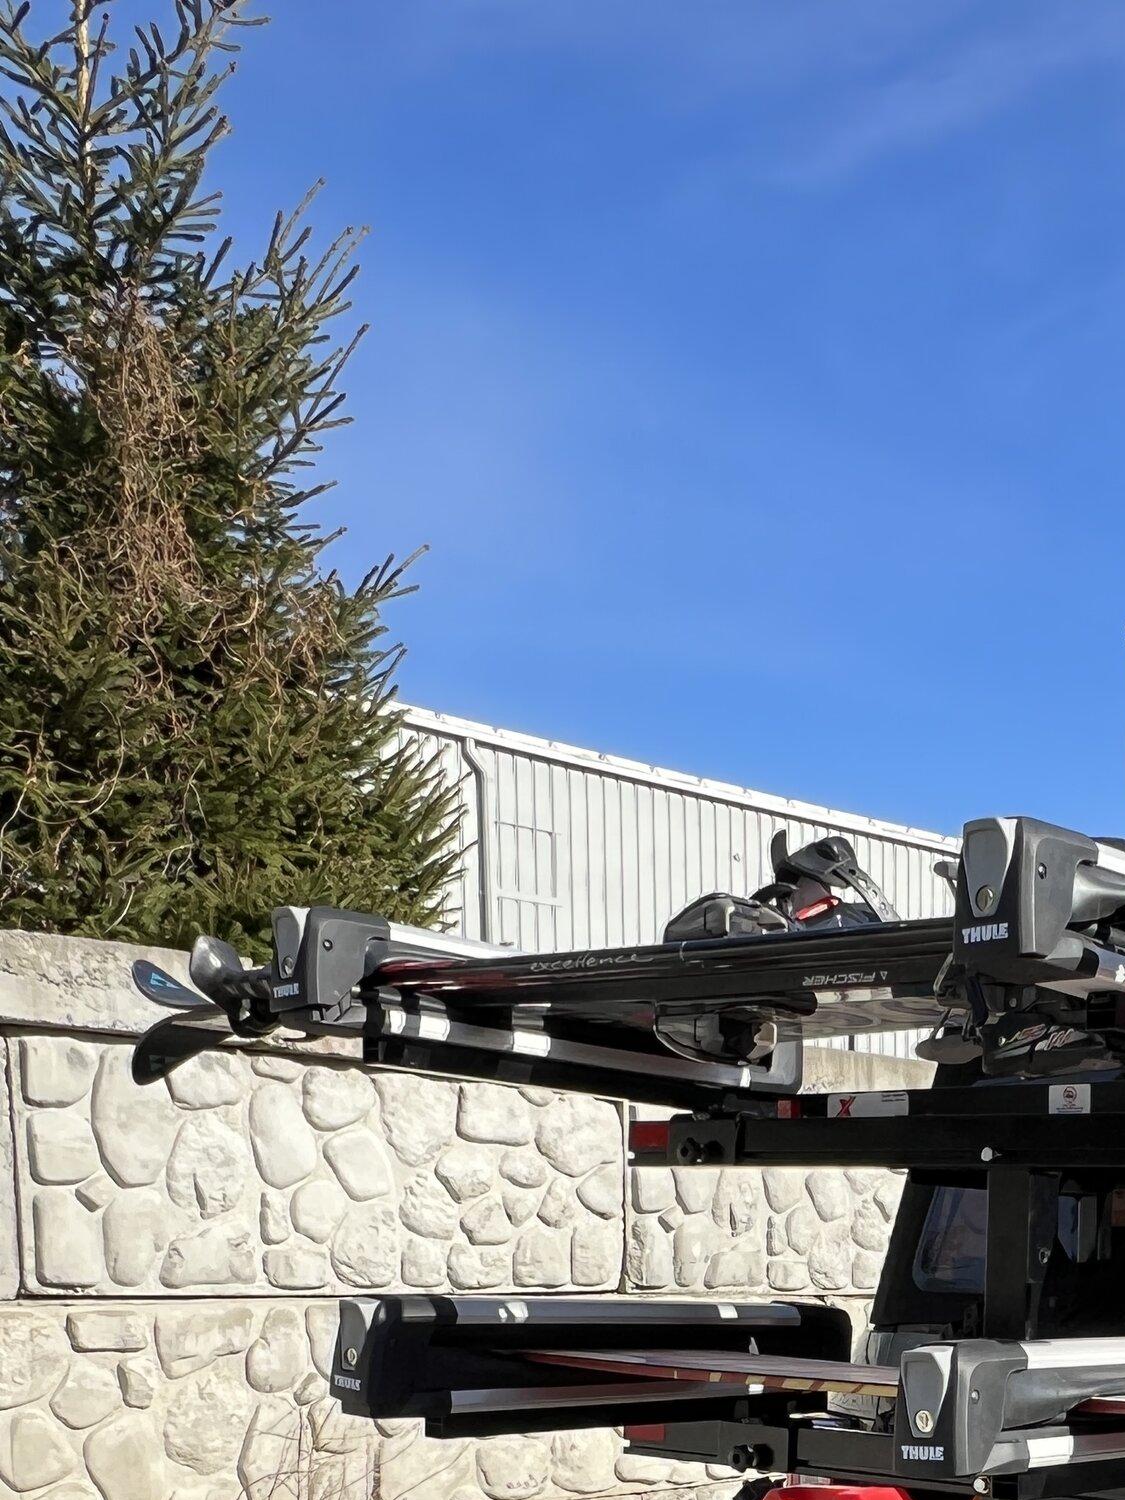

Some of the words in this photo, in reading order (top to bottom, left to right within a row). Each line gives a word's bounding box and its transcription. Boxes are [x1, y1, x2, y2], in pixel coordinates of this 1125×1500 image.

[962, 922, 1009, 944] THULE
[803, 971, 876, 986] FISCHER
[901, 1445, 944, 1461] THULE
